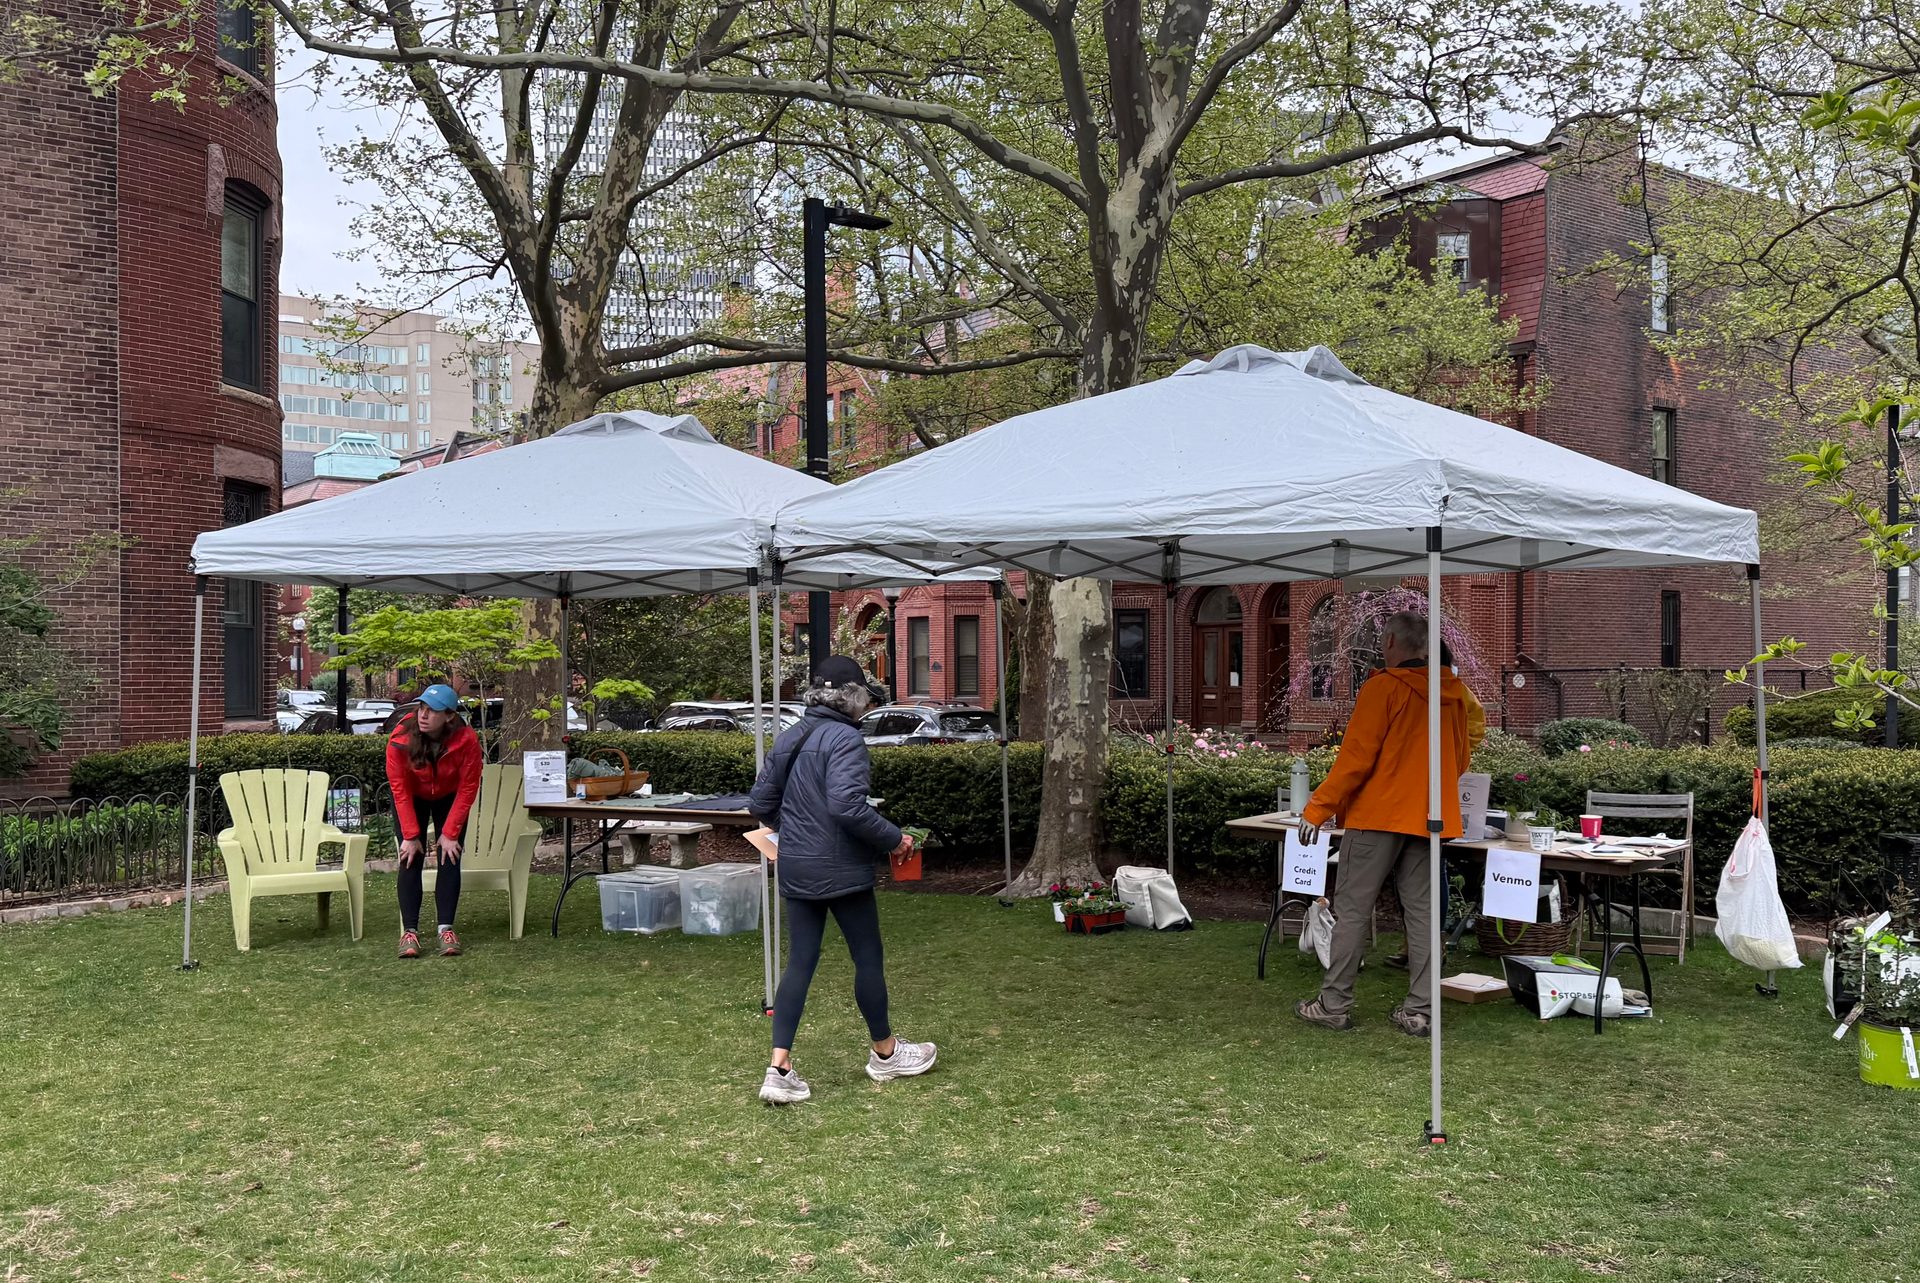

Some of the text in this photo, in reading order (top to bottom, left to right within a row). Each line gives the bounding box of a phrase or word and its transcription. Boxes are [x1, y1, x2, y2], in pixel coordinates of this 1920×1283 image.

[1294, 866, 1316, 875] Credit
[1295, 878, 1312, 886] Card
[1492, 872, 1532, 886] Venmo
